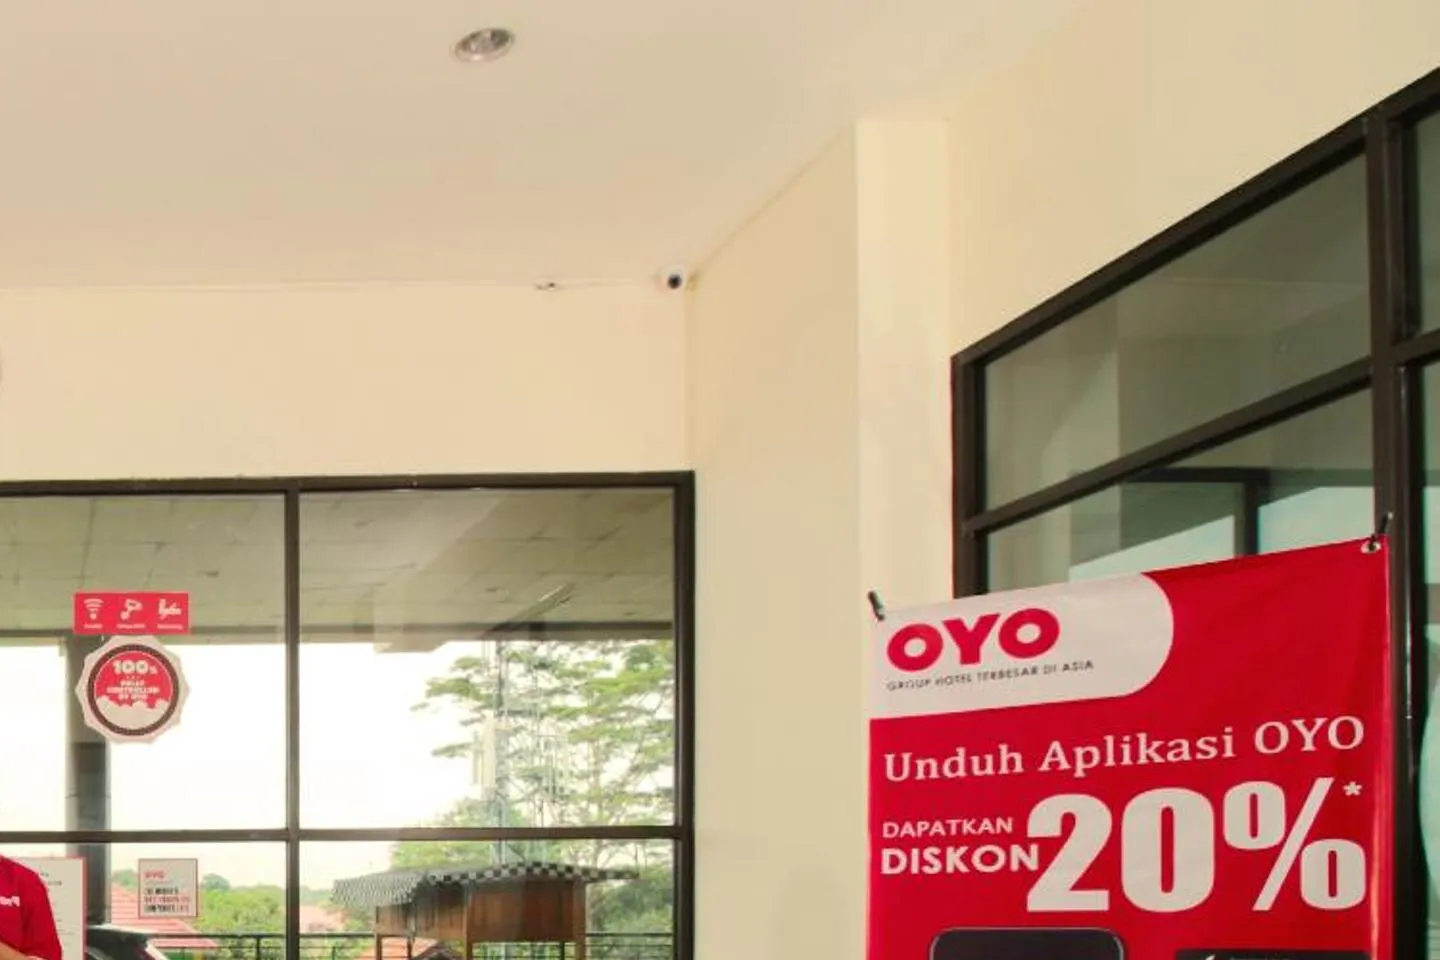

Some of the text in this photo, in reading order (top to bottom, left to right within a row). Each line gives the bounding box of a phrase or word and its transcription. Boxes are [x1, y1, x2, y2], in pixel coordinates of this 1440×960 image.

[887, 608, 1060, 672] OYO
[886, 660, 1094, 692] GROUP HOTEL TERBESAR DI ASIA
[884, 715, 1365, 782] Unduh Aplikasi OYO
[882, 816, 1014, 839] DAPATKAN
[880, 843, 1040, 876] DISKON
